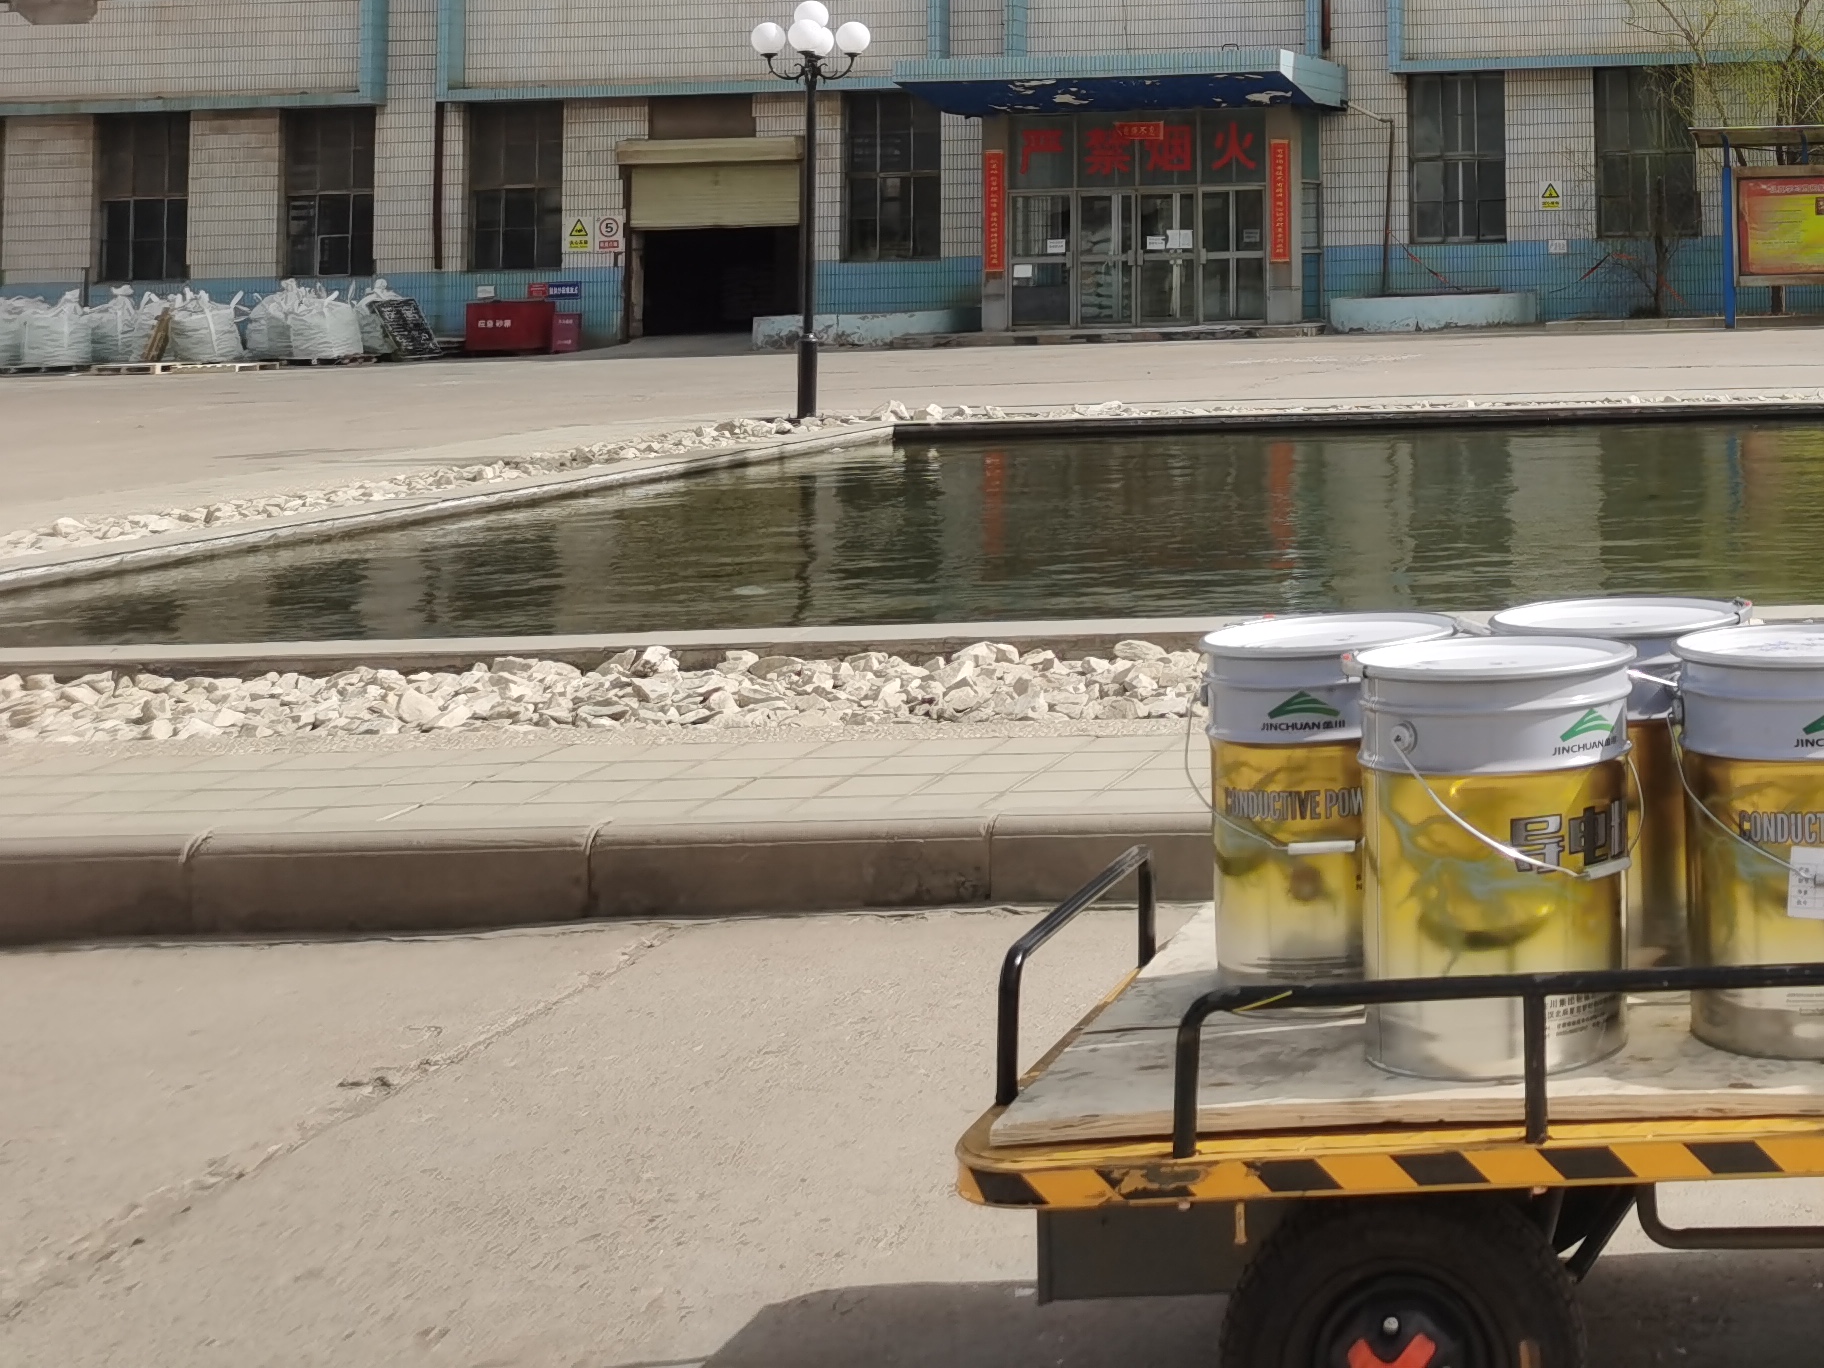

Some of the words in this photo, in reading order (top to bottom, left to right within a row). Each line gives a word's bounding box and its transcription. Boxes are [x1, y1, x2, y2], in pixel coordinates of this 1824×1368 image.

[1019, 121, 1257, 176] 严禁烟火
[605, 222, 614, 234] 5
